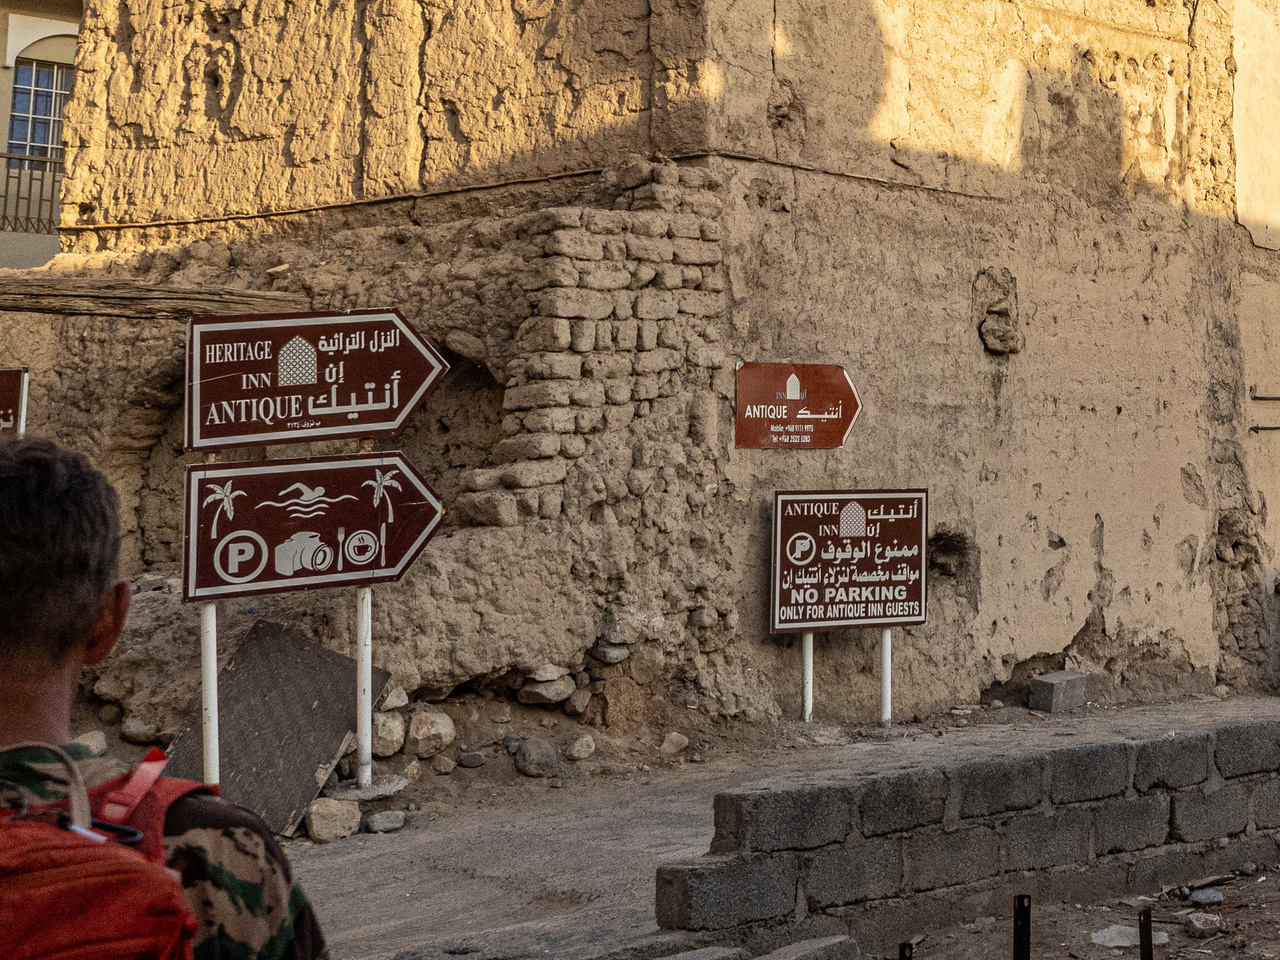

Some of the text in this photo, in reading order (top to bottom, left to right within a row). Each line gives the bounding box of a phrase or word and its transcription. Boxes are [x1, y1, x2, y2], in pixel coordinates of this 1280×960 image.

[205, 340, 273, 364] HERITAGE
[318, 329, 400, 356] النزل التراثية
[241, 372, 272, 390] INN
[324, 361, 345, 384] إن
[307, 370, 401, 419] أنتيك
[205, 394, 303, 425] ANTIQUE
[745, 405, 788, 419] ANTIQUE
[796, 400, 842, 422] أنتيك
[784, 502, 839, 518] ANTIQUE
[867, 499, 919, 522] أنتيك
[818, 524, 838, 536] INN
[867, 522, 880, 537] إن
[228, 542, 255, 574] P
[821, 539, 919, 564] ممنوع الوقوف
[851, 565, 889, 583] مخصصة
[891, 563, 920, 585] مواقف
[790, 585, 907, 604] NO PARKING
[780, 601, 920, 620] ONLY FOR ANTIQUE INN GUESTS
